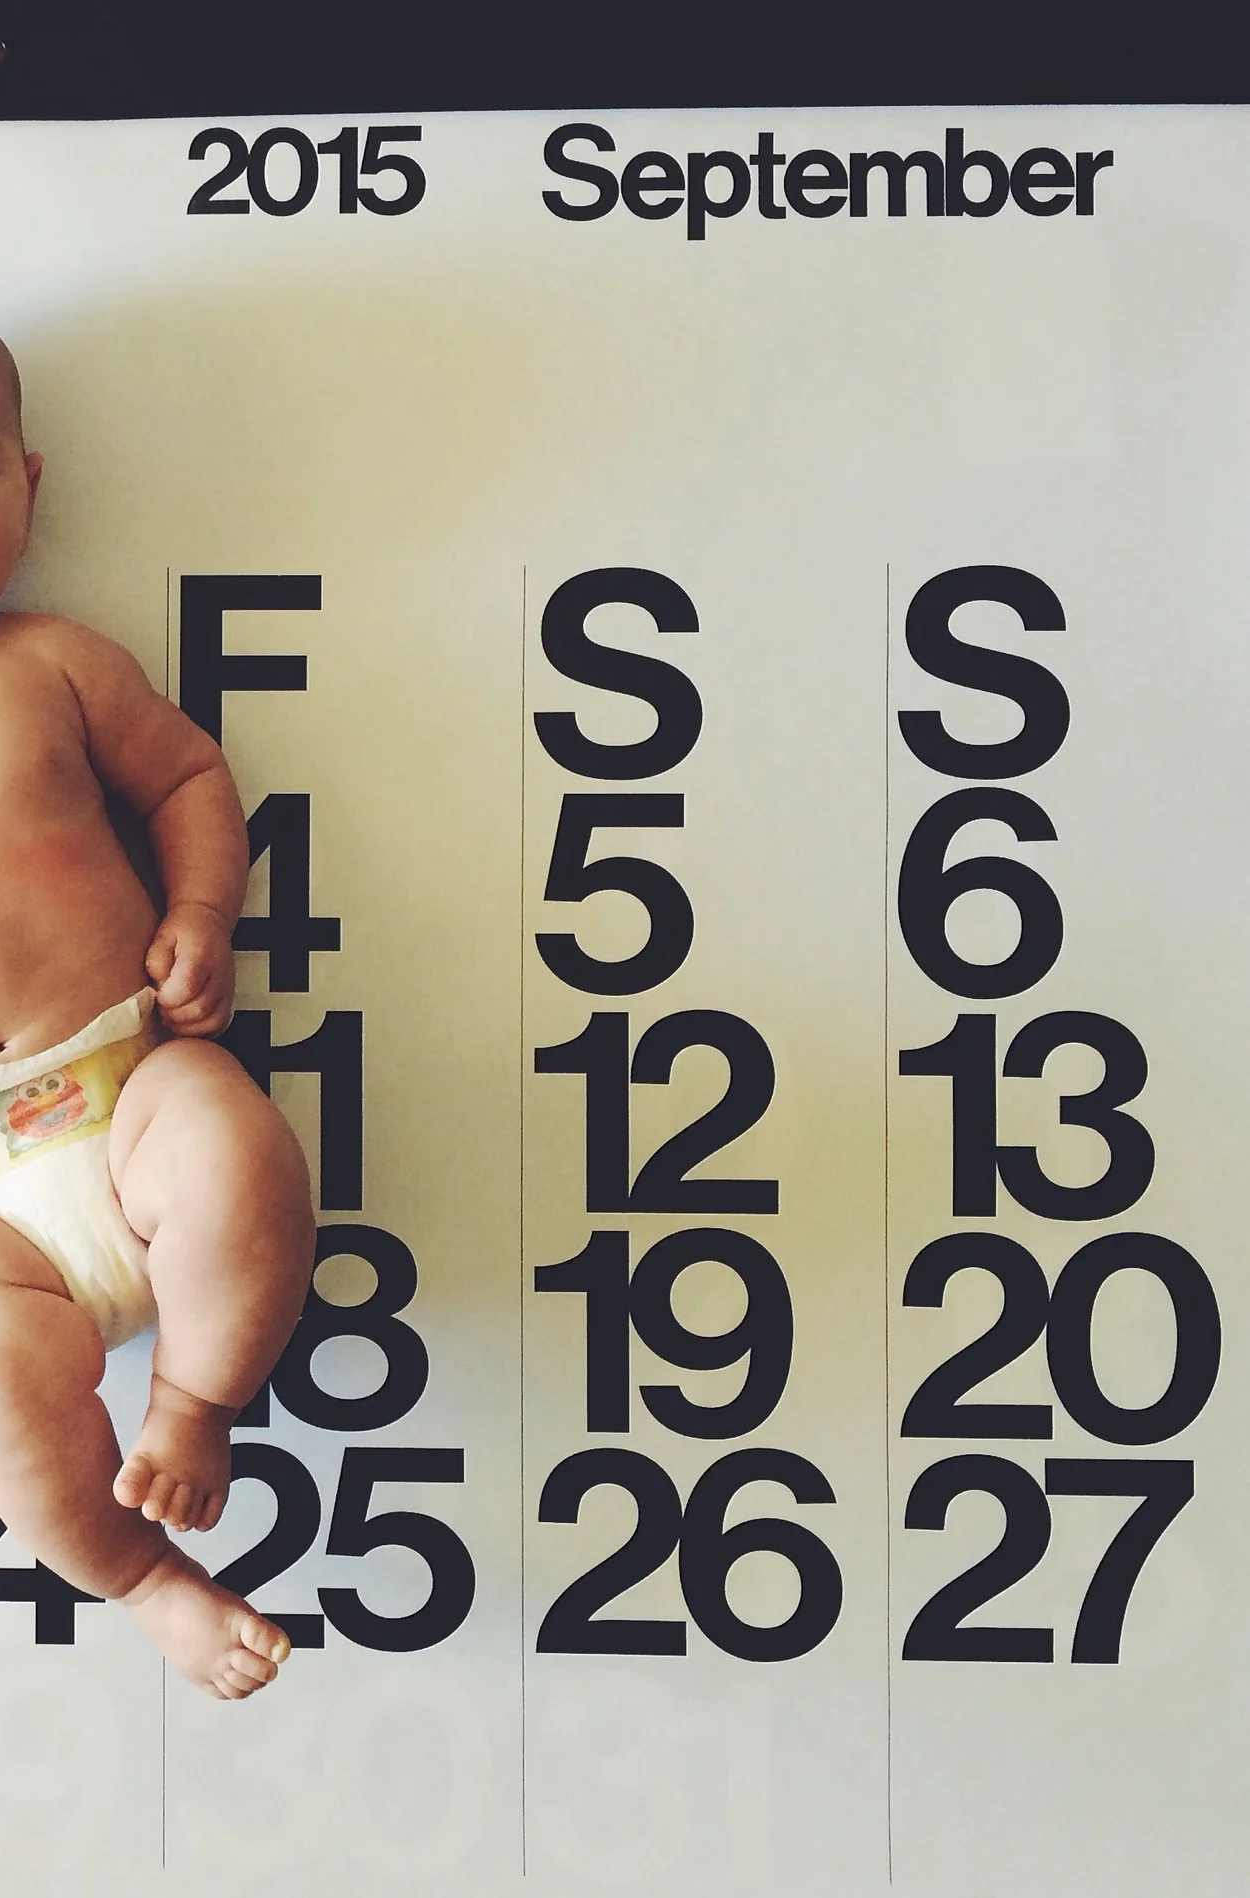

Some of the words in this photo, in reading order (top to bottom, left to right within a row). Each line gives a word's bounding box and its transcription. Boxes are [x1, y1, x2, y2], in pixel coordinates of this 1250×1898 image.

[187, 126, 427, 217] 2015
[542, 123, 1114, 241] September
[179, 575, 321, 750] F
[534, 567, 703, 781] S
[898, 565, 1071, 781] S
[535, 793, 695, 997] 5
[898, 787, 1064, 1000] 6
[534, 1010, 779, 1215] 12
[899, 1011, 1156, 1222] 13
[534, 1228, 794, 1440] 19
[901, 1231, 1222, 1446] 20
[536, 1448, 843, 1663] 26
[902, 1454, 1195, 1665] 27
